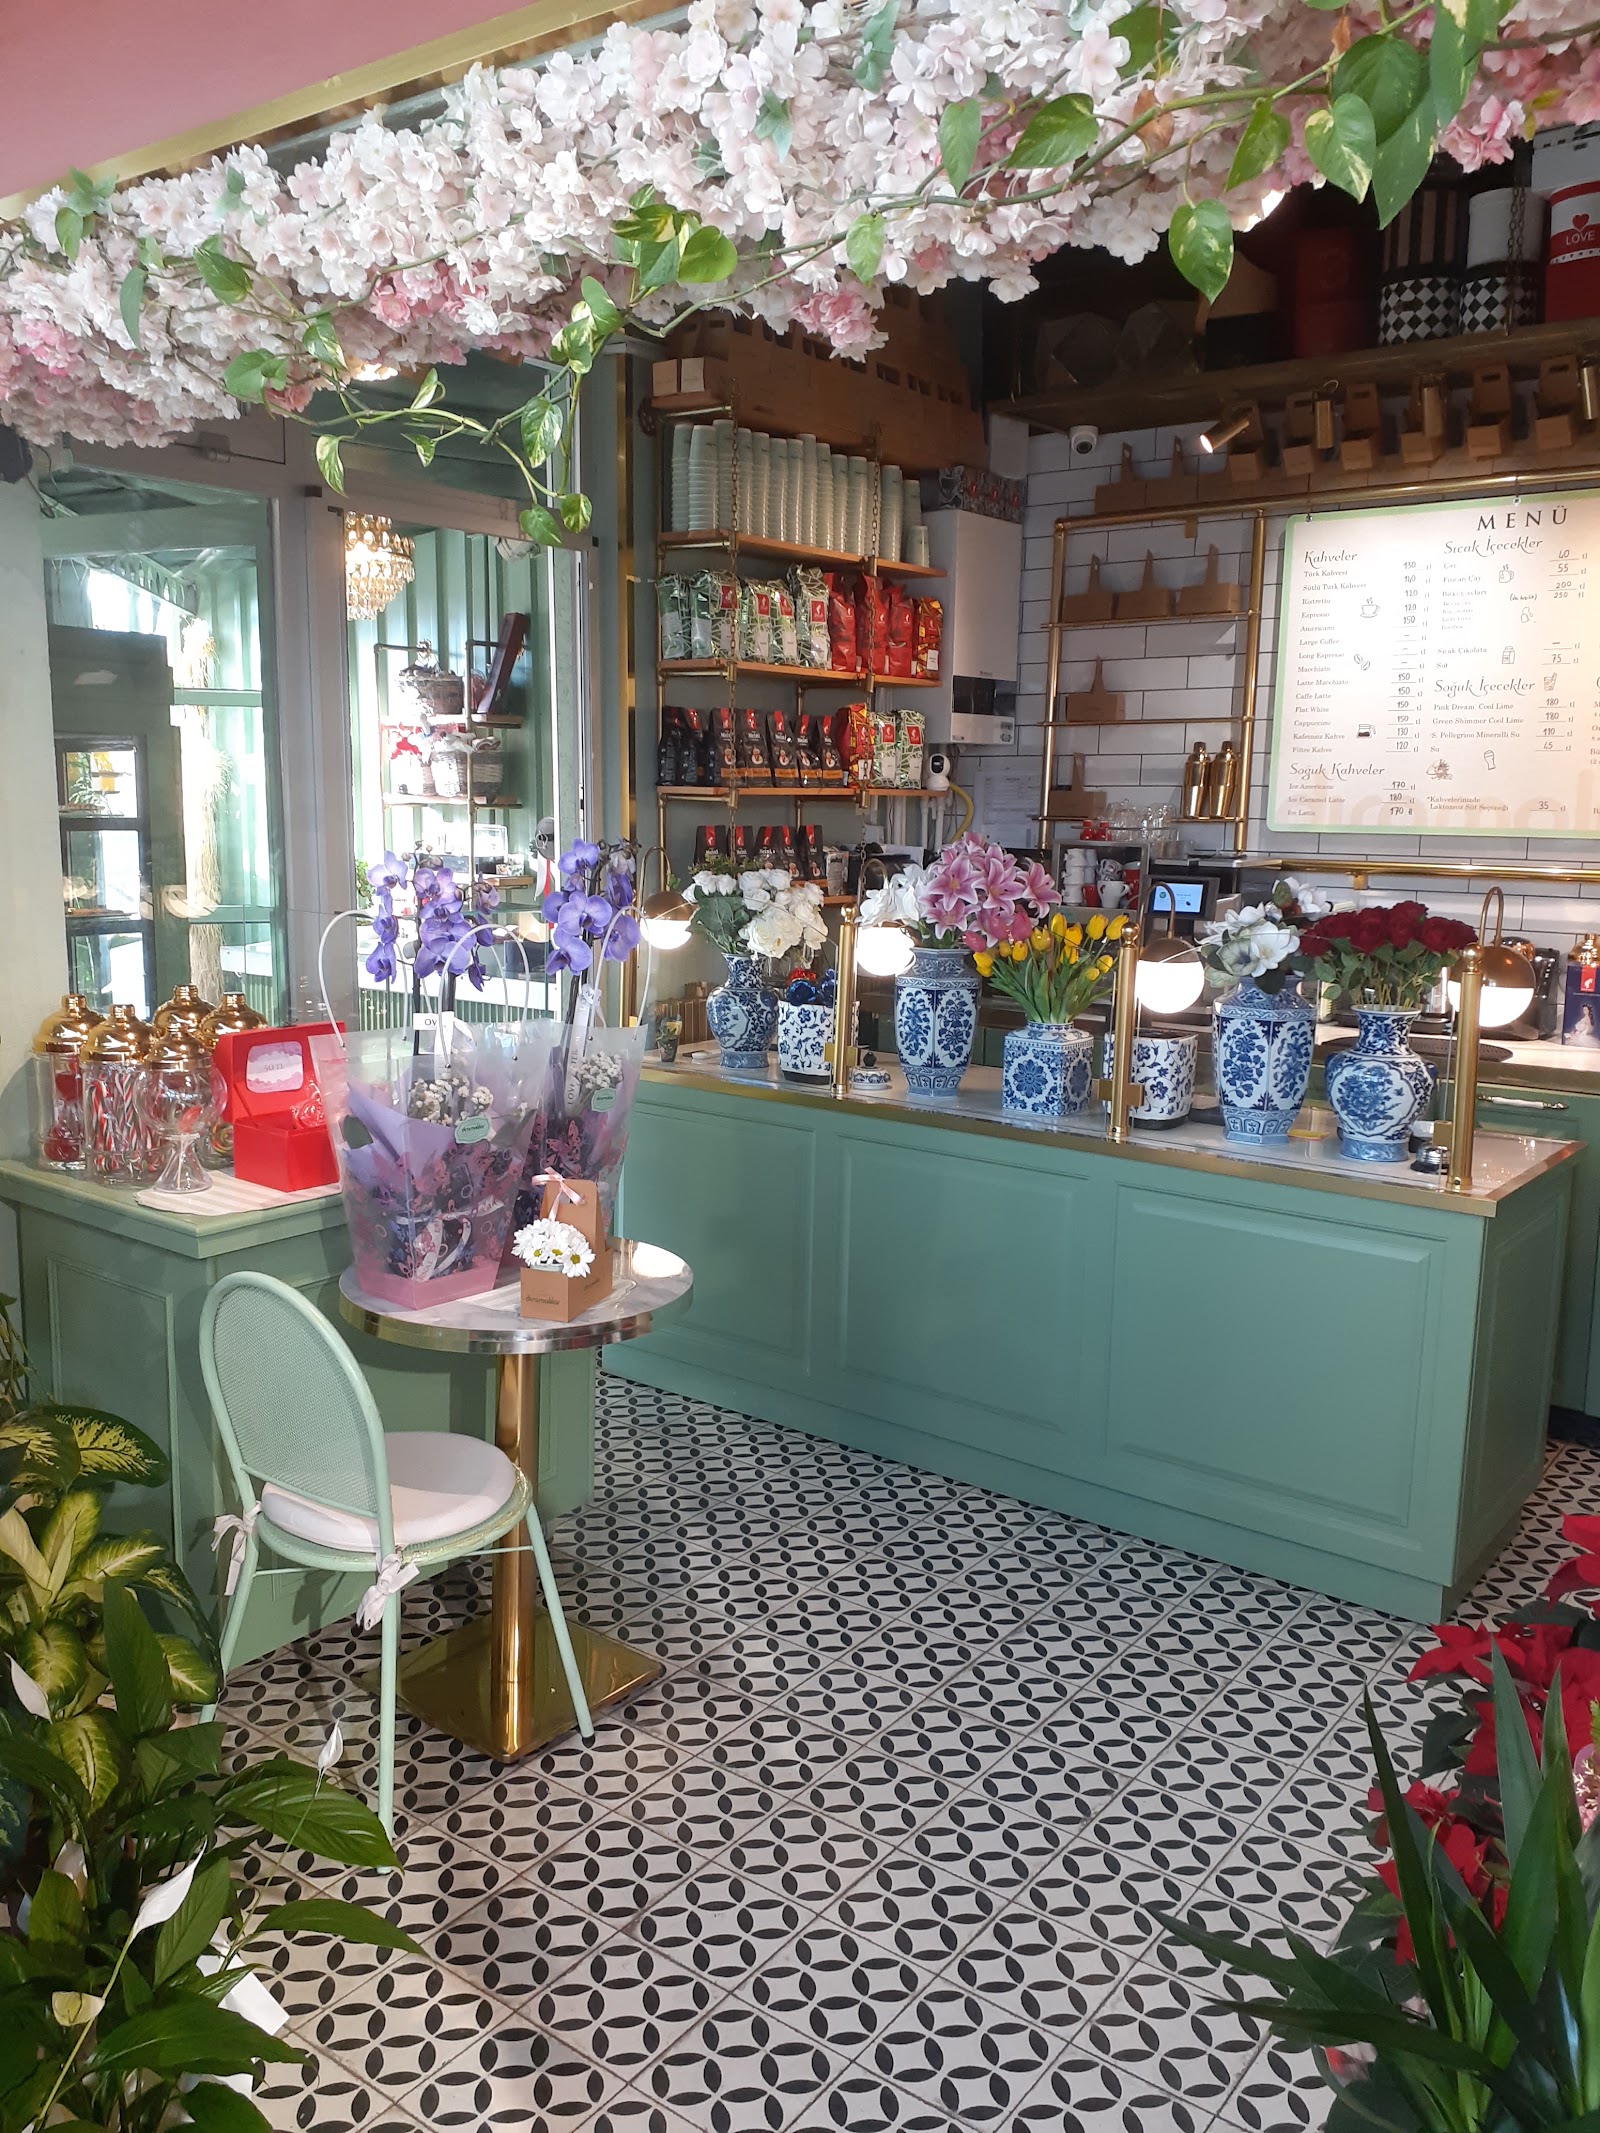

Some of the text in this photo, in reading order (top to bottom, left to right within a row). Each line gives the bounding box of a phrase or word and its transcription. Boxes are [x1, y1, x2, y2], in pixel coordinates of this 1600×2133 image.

[1566, 230, 1596, 246] LOVE
[1477, 505, 1567, 531] MENÜ
[1304, 550, 1358, 569] Kahveler
[1558, 564, 1569, 572] 55
[1556, 581, 1571, 589] 200
[1405, 589, 1418, 597] 120
[1404, 616, 1415, 624] 150
[1552, 654, 1561, 663] 75
[1398, 673, 1410, 681] 150
[1397, 687, 1410, 695] 150
[1397, 728, 1408, 736] 130
[1396, 741, 1408, 750] 120
[1332, 763, 1385, 781] Kahveler
[1392, 781, 1406, 789] 170
[1539, 801, 1549, 810] 35
[1390, 807, 1404, 815] 170
